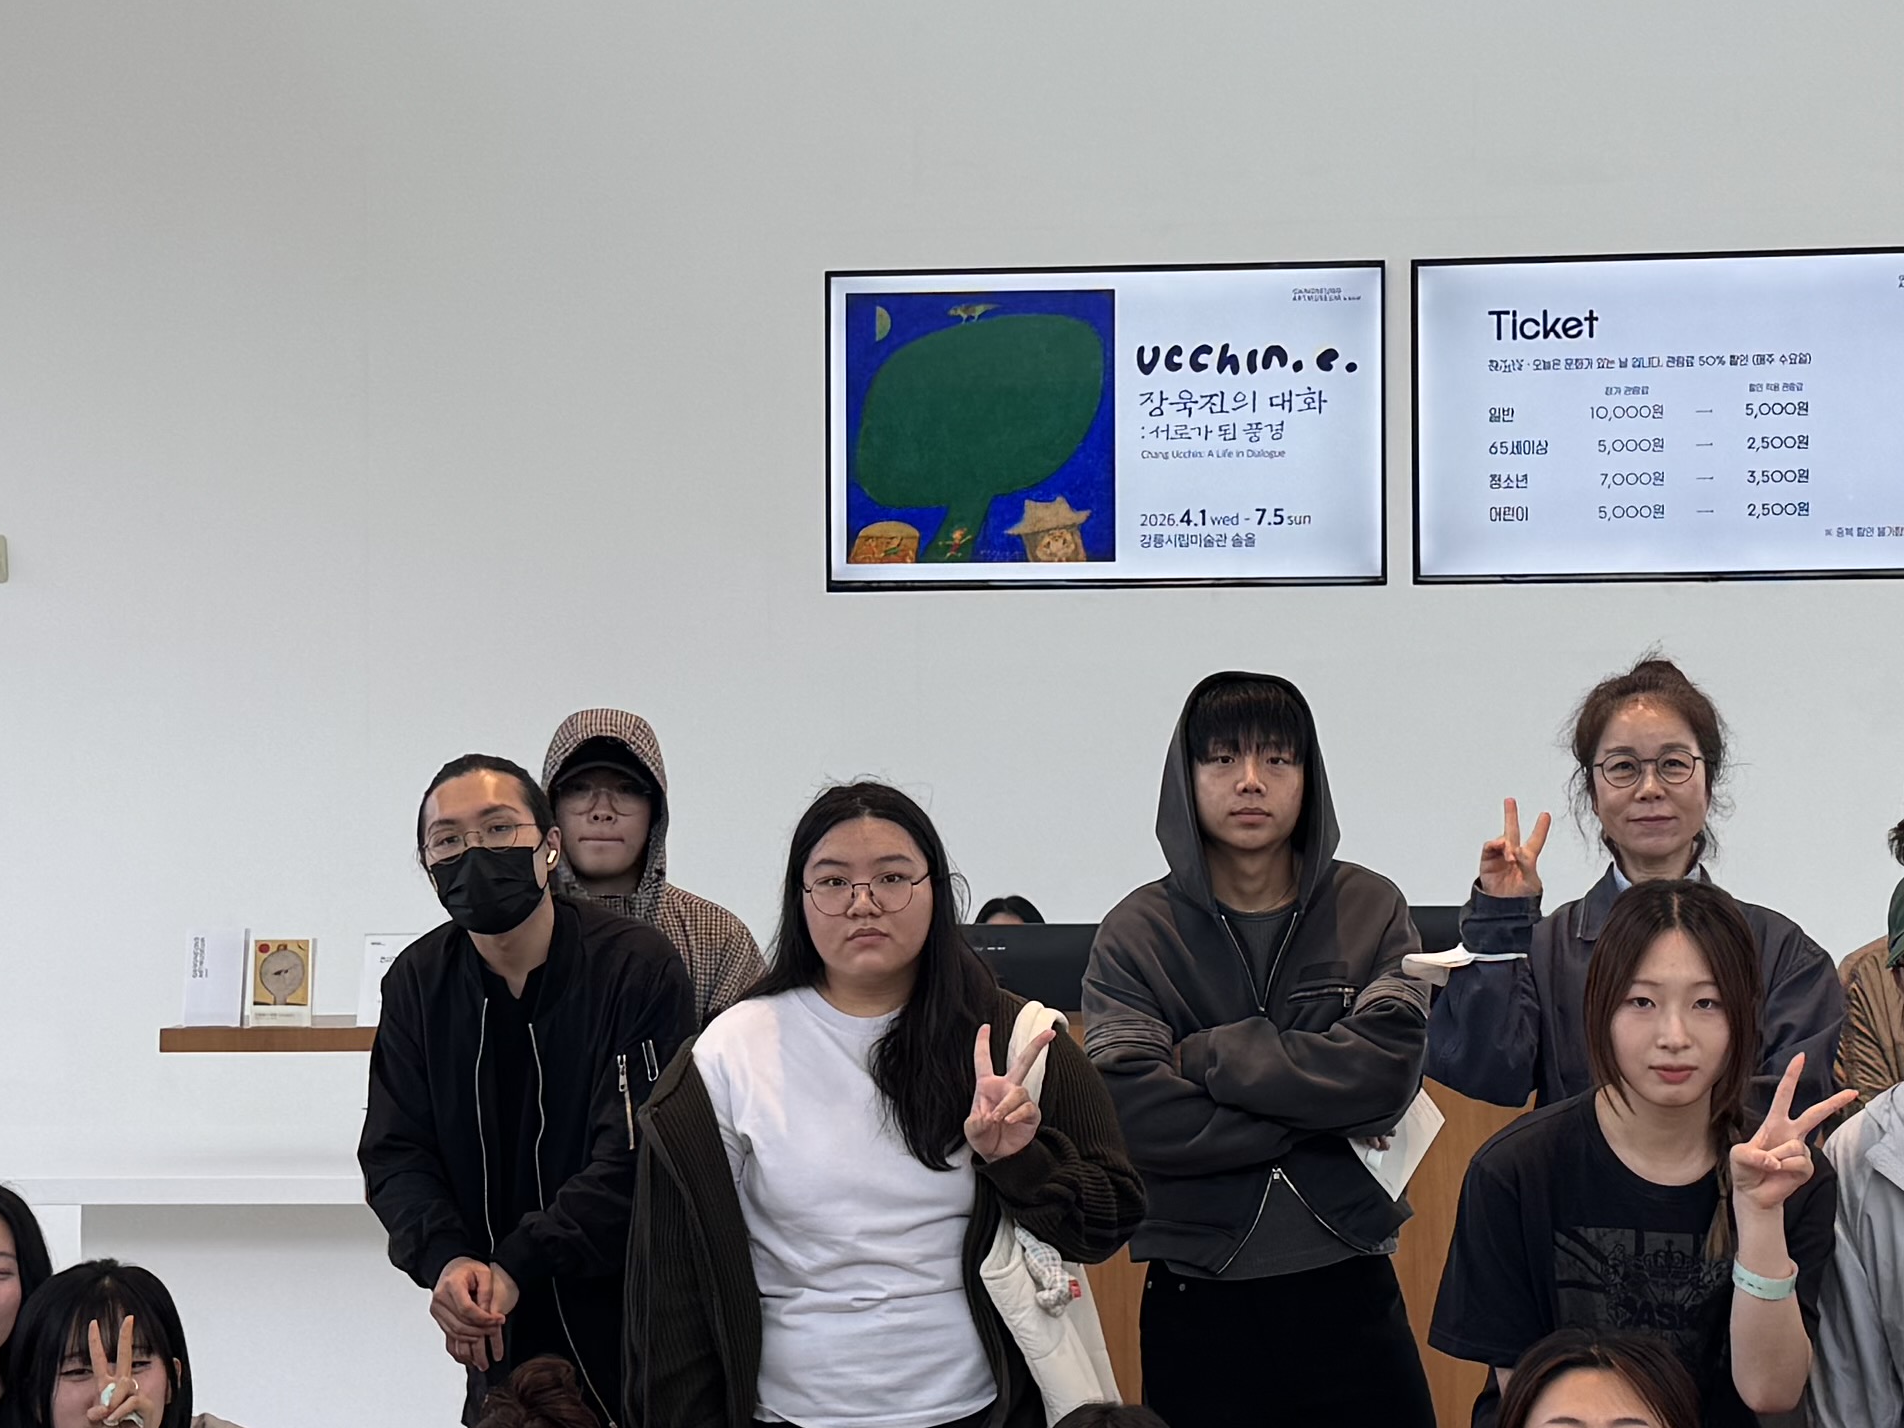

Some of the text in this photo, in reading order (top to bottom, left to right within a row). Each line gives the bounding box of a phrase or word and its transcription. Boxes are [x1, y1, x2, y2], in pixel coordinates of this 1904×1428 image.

[1487, 309, 1599, 341] Ticket
[1698, 355, 1726, 367] 50%
[1139, 387, 1328, 418] 장욱진의 대화
[1488, 400, 1809, 423] 일반 10,000원 5,000원
[1149, 424, 1213, 441] 서로가
[1218, 422, 1237, 442] 된
[1243, 421, 1285, 443] 풍경
[1216, 449, 1234, 458] Life
[1236, 450, 1245, 458] in
[1246, 450, 1286, 460] Dialogue
[1488, 435, 1809, 456] 65세이상 5,000원 2,500원
[1489, 469, 1809, 490] 청소년 7,000원 3,500원
[1489, 502, 1810, 522] 어린이 5,000원 2,500원
